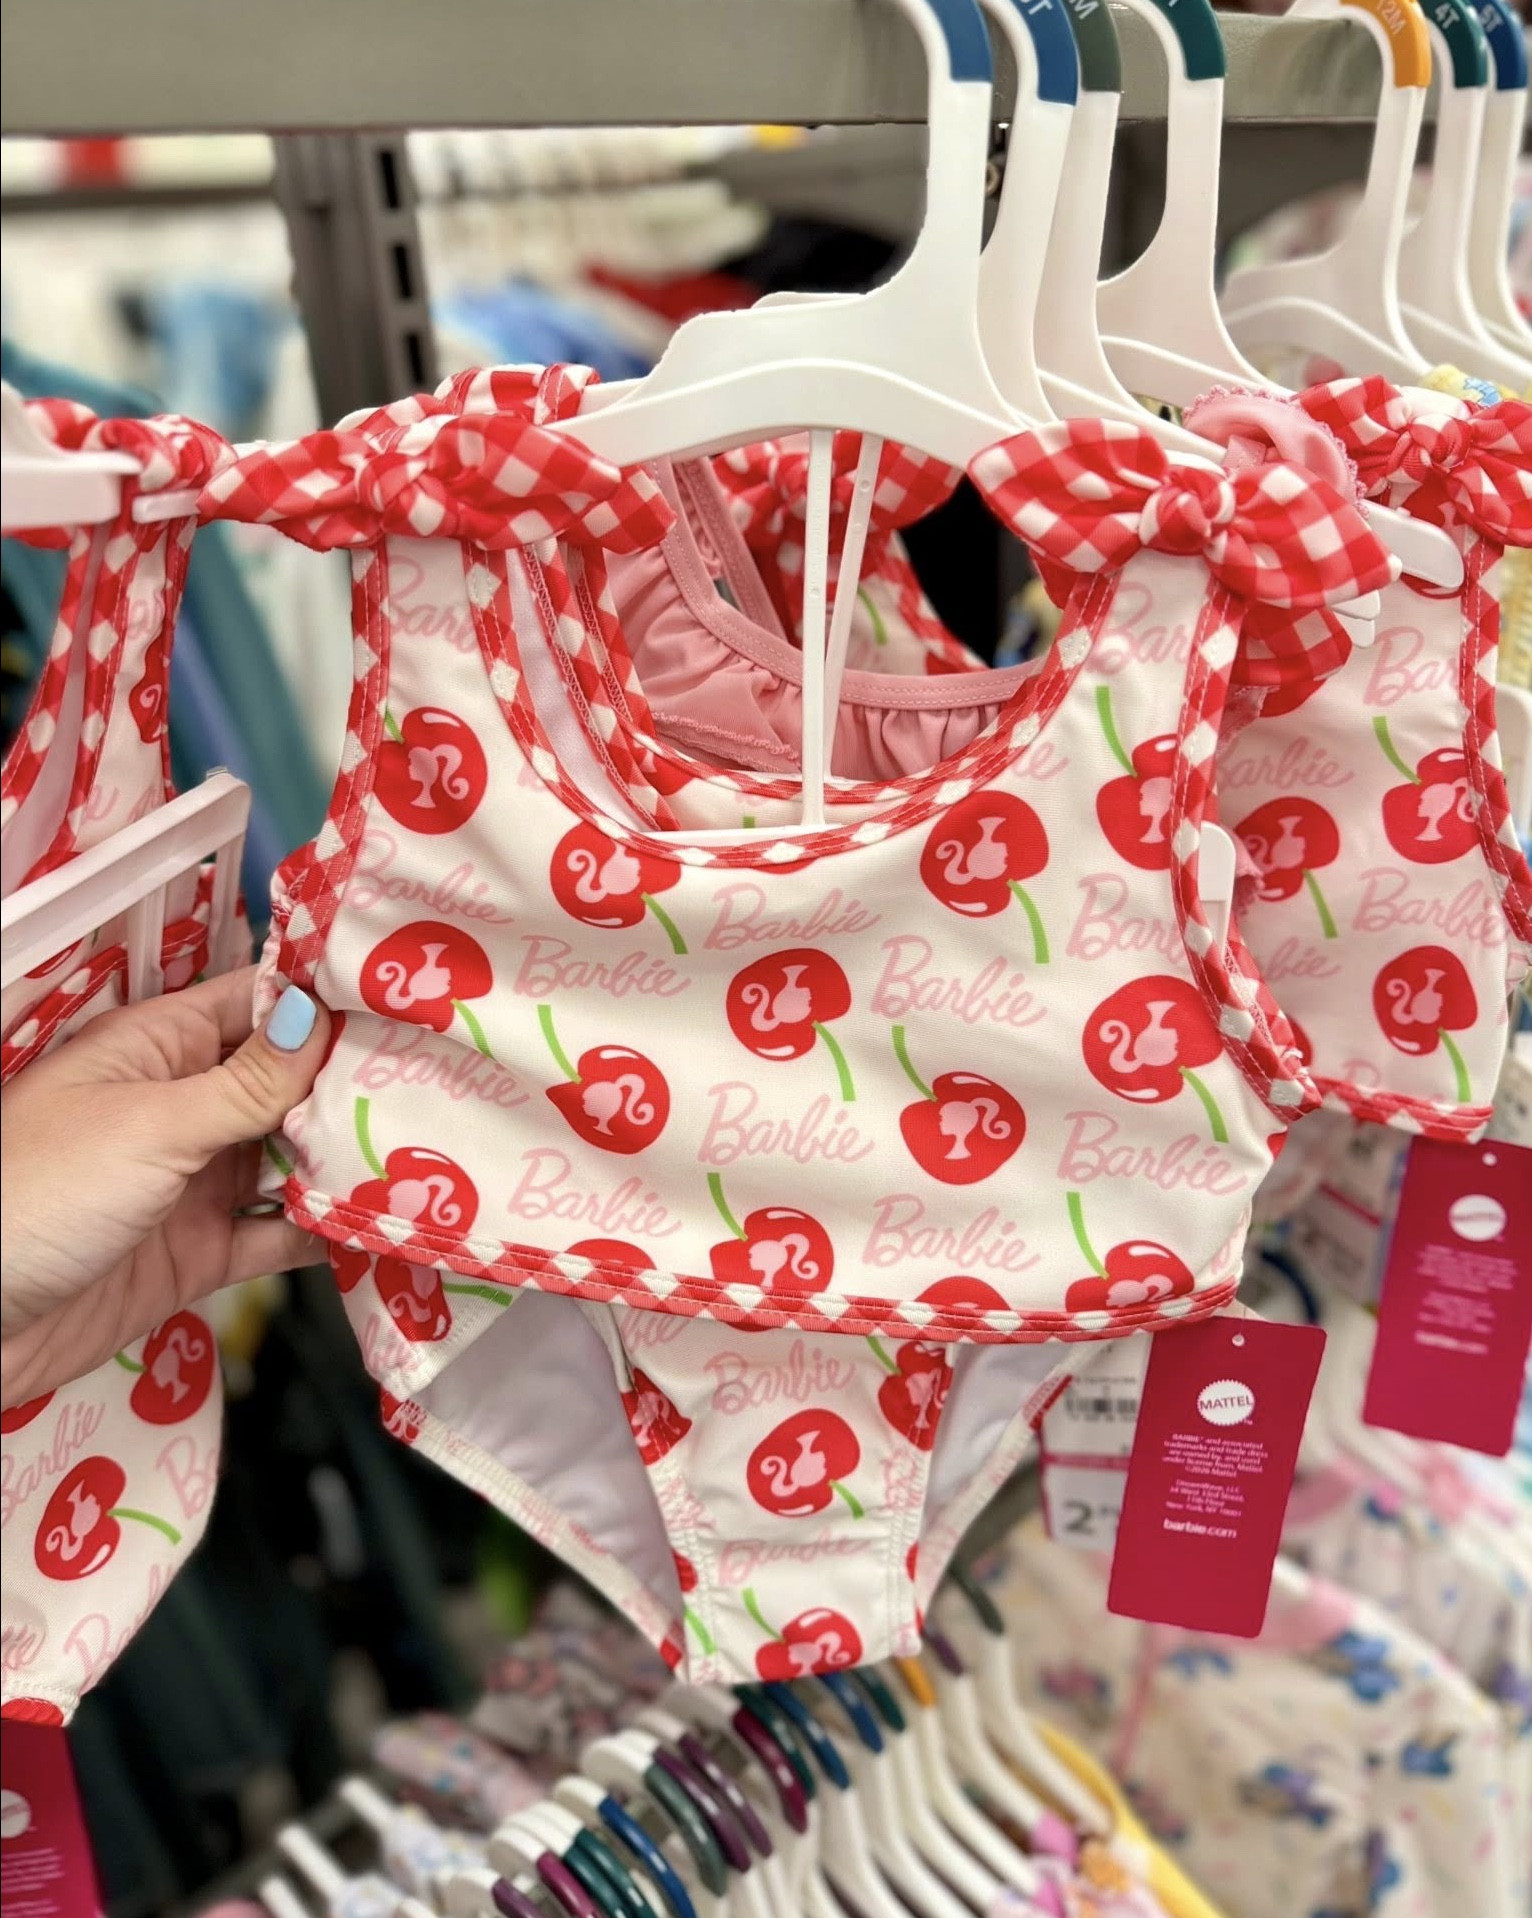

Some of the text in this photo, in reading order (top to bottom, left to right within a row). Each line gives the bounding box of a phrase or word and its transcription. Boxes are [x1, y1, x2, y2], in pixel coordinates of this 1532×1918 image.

[1434, 3, 1460, 29] 4T
[703, 882, 883, 950] Barbie
[513, 934, 692, 998] Barbie
[870, 935, 1047, 1026] Barbie
[698, 1081, 875, 1167] Barbie
[1057, 1110, 1247, 1197] Barbie
[507, 1148, 684, 1239] Barbie
[863, 1194, 1042, 1275] Barbie
[703, 1338, 856, 1415] Barbie
[1199, 1395, 1253, 1411] MATTEL
[1163, 1441, 1269, 1458] trademarks and trade dress
[1163, 1517, 1237, 1538] barbie.com
